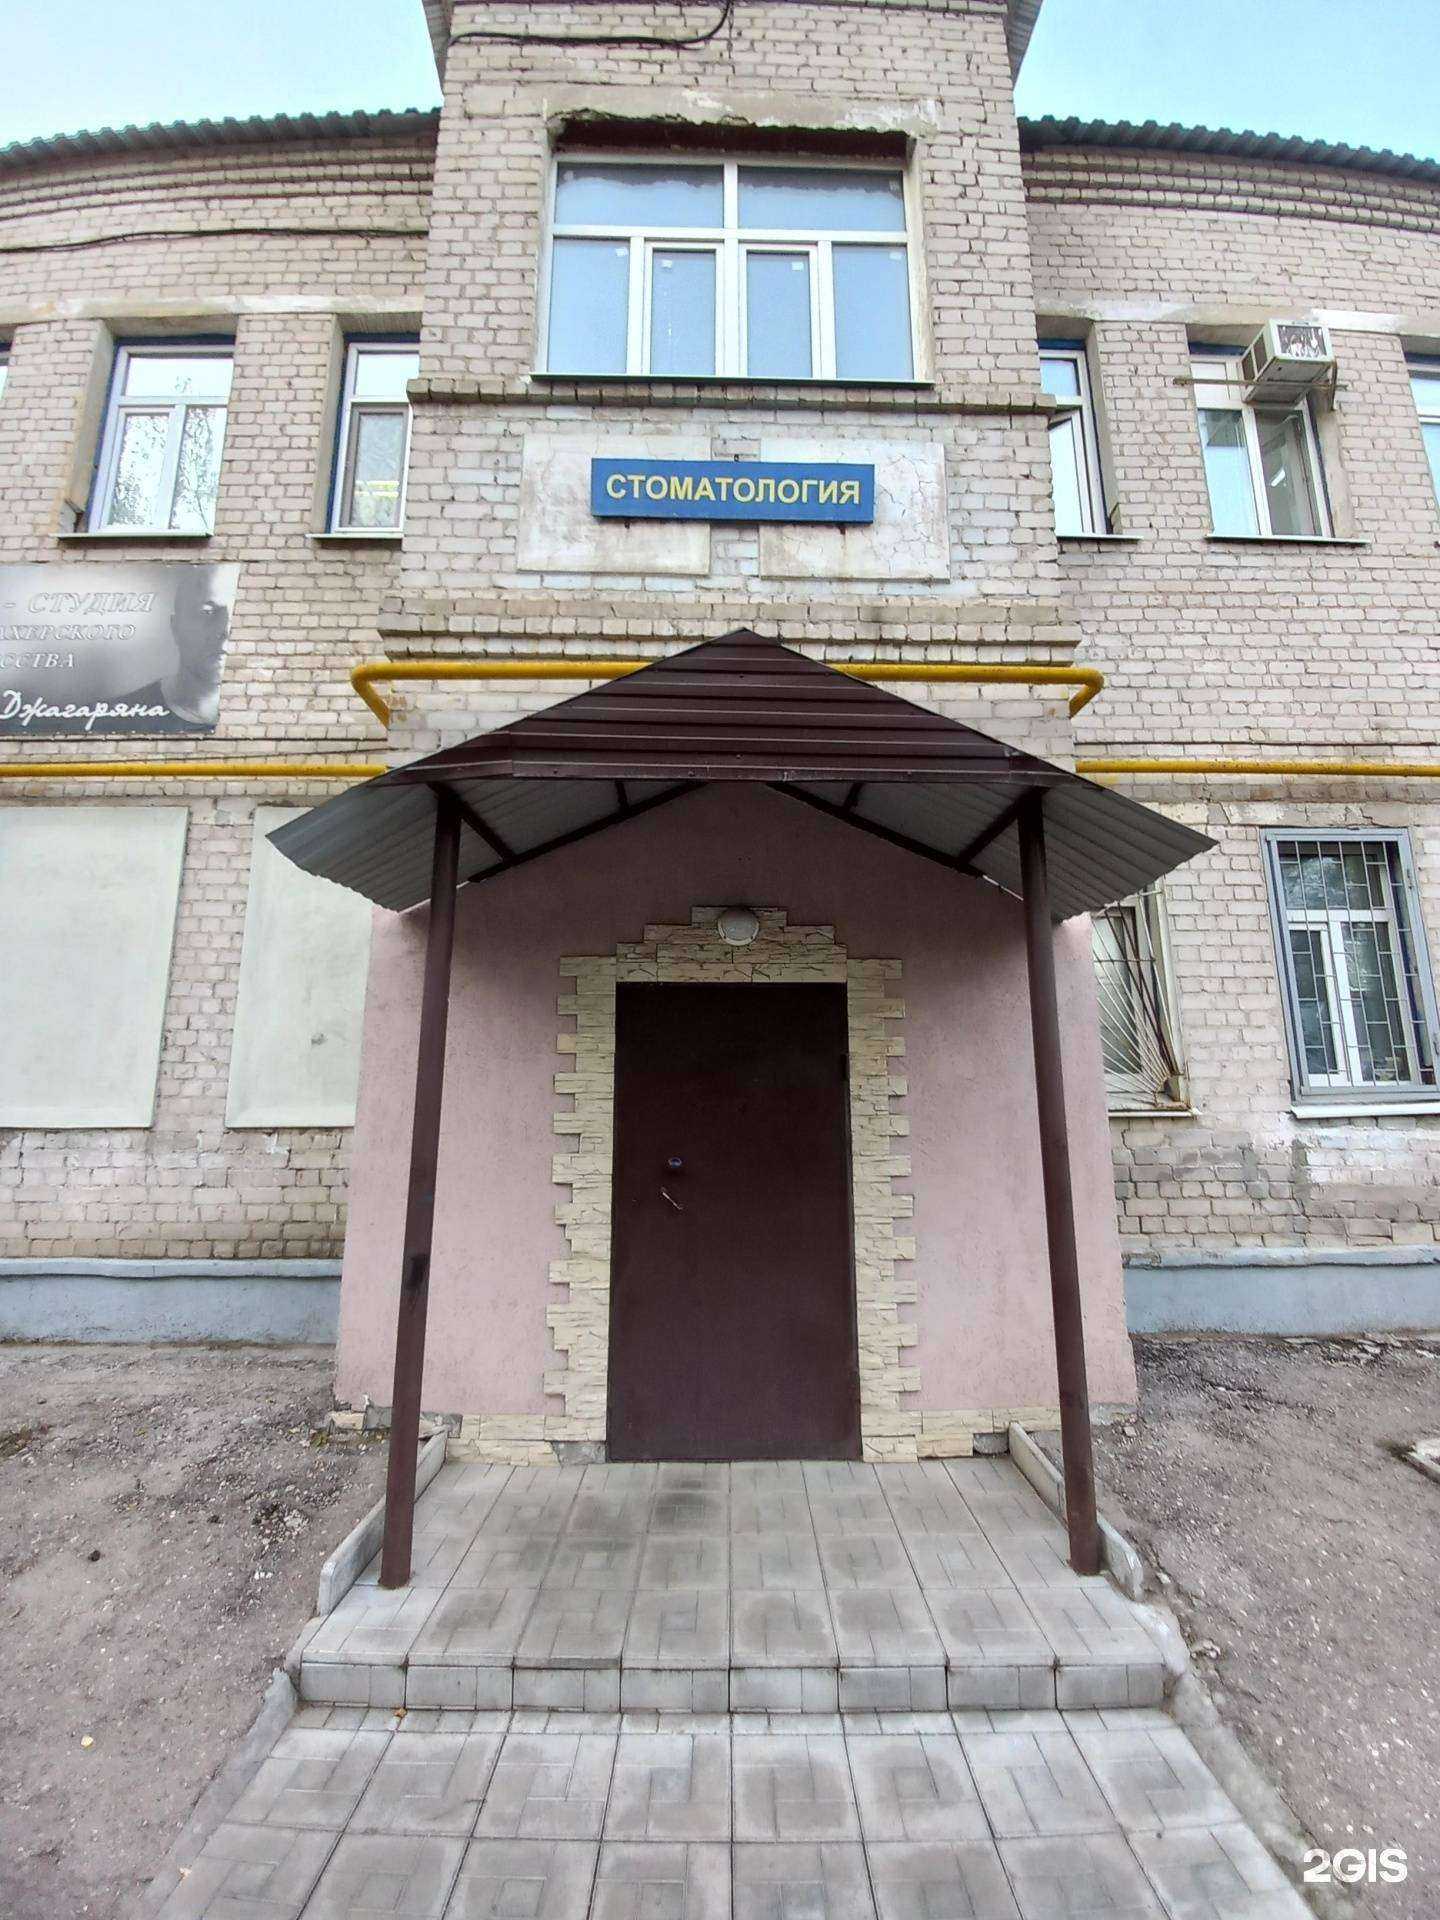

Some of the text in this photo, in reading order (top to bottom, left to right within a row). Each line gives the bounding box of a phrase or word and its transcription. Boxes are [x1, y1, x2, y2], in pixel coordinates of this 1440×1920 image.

[606, 474, 860, 505] СТОМАТОЛОГИЯ
[28, 592, 156, 615] СТУДИЯ
[0, 690, 170, 731] Джагаряна
